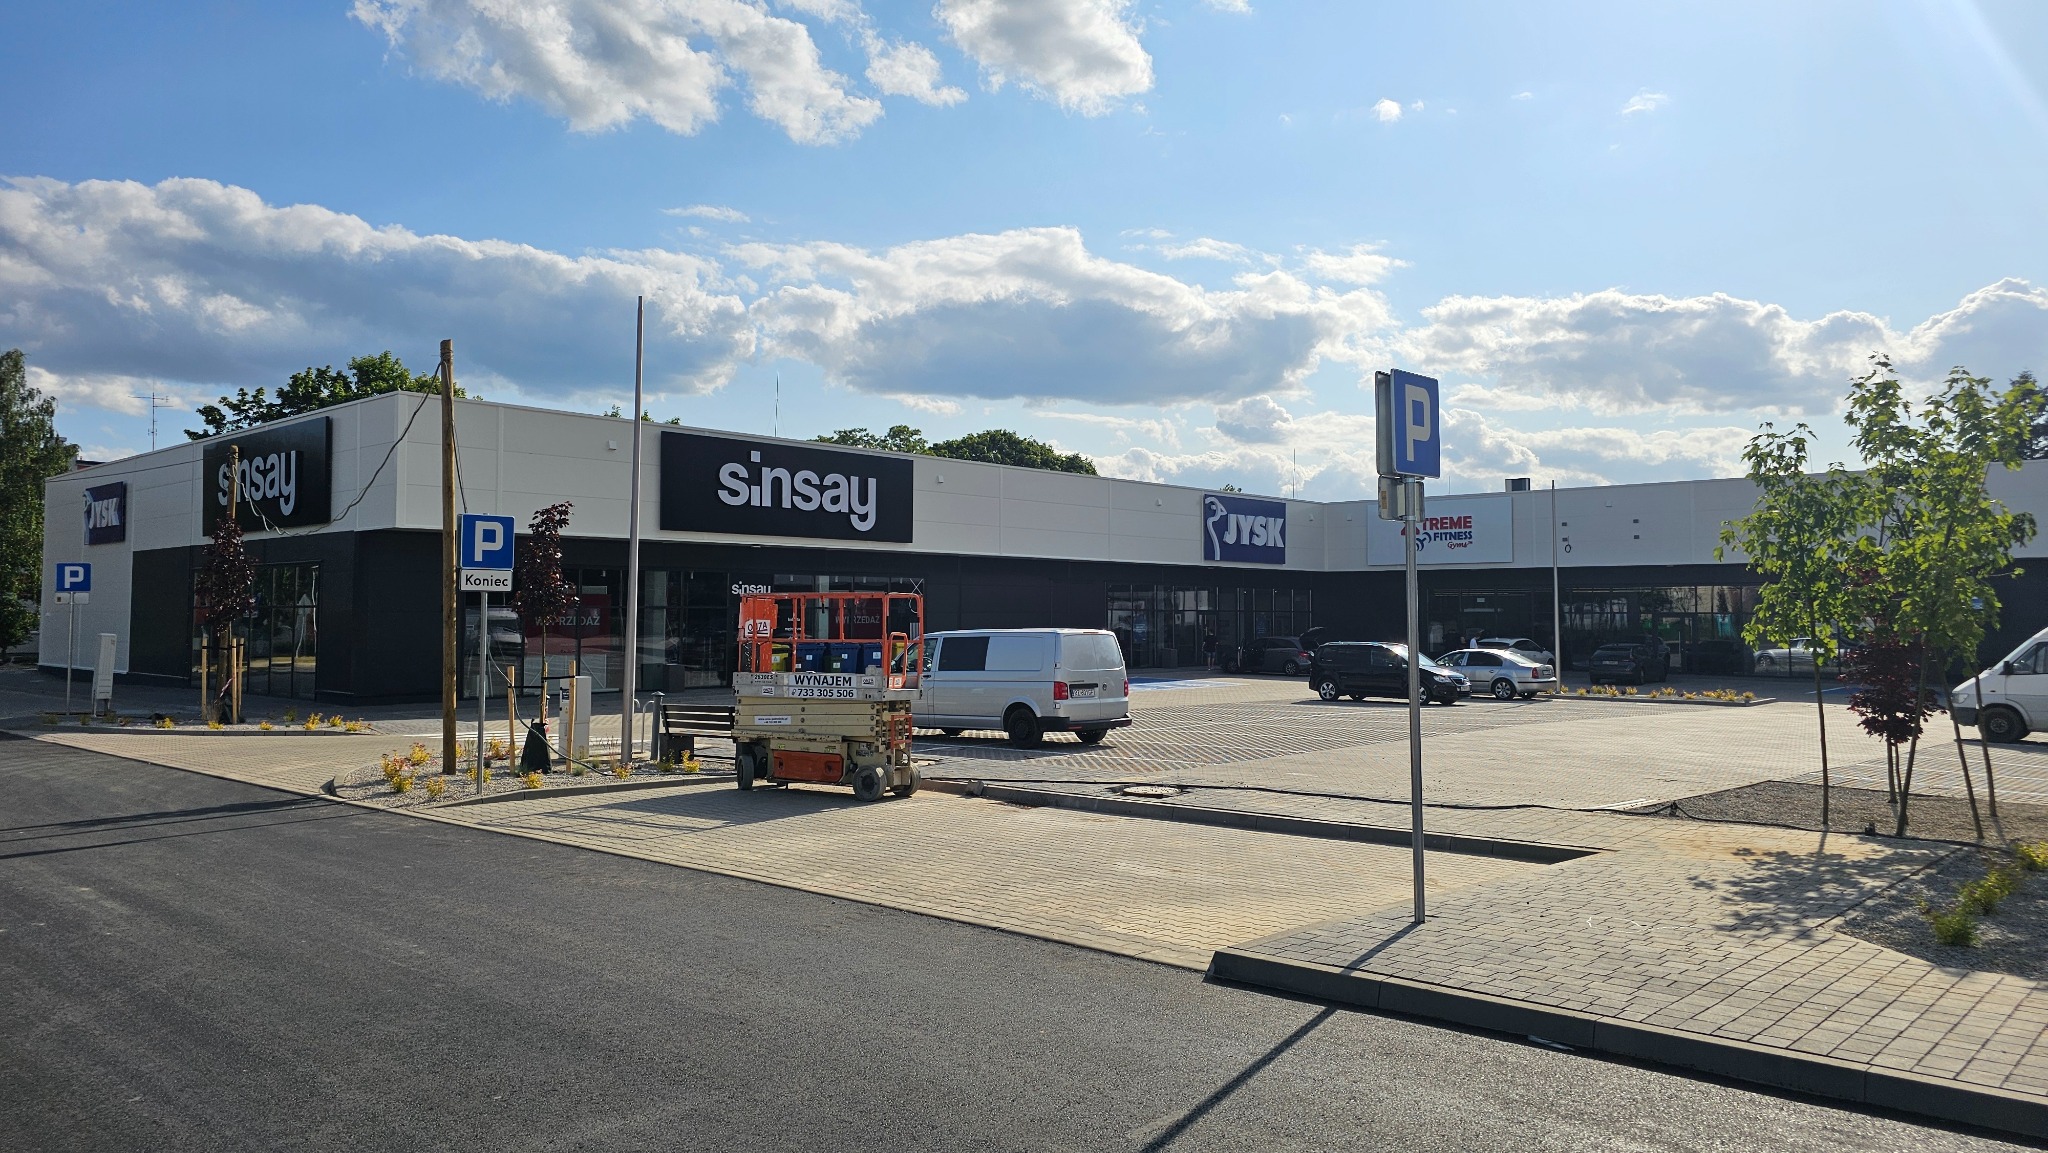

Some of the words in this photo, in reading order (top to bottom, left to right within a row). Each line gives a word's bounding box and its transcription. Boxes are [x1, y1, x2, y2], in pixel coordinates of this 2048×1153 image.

[1404, 384, 1431, 461] P
[217, 451, 296, 516] snsay
[717, 450, 877, 532] sinsay
[89, 497, 120, 530] JYSK
[1223, 513, 1285, 547] JYSK
[474, 520, 504, 562] P
[1433, 531, 1473, 541] FITNESS
[64, 566, 85, 588] P
[465, 574, 509, 587] Koniec
[794, 674, 852, 687] WYNAJEM
[798, 688, 815, 698] 733
[816, 689, 834, 698] 305
[836, 689, 854, 698] 506
